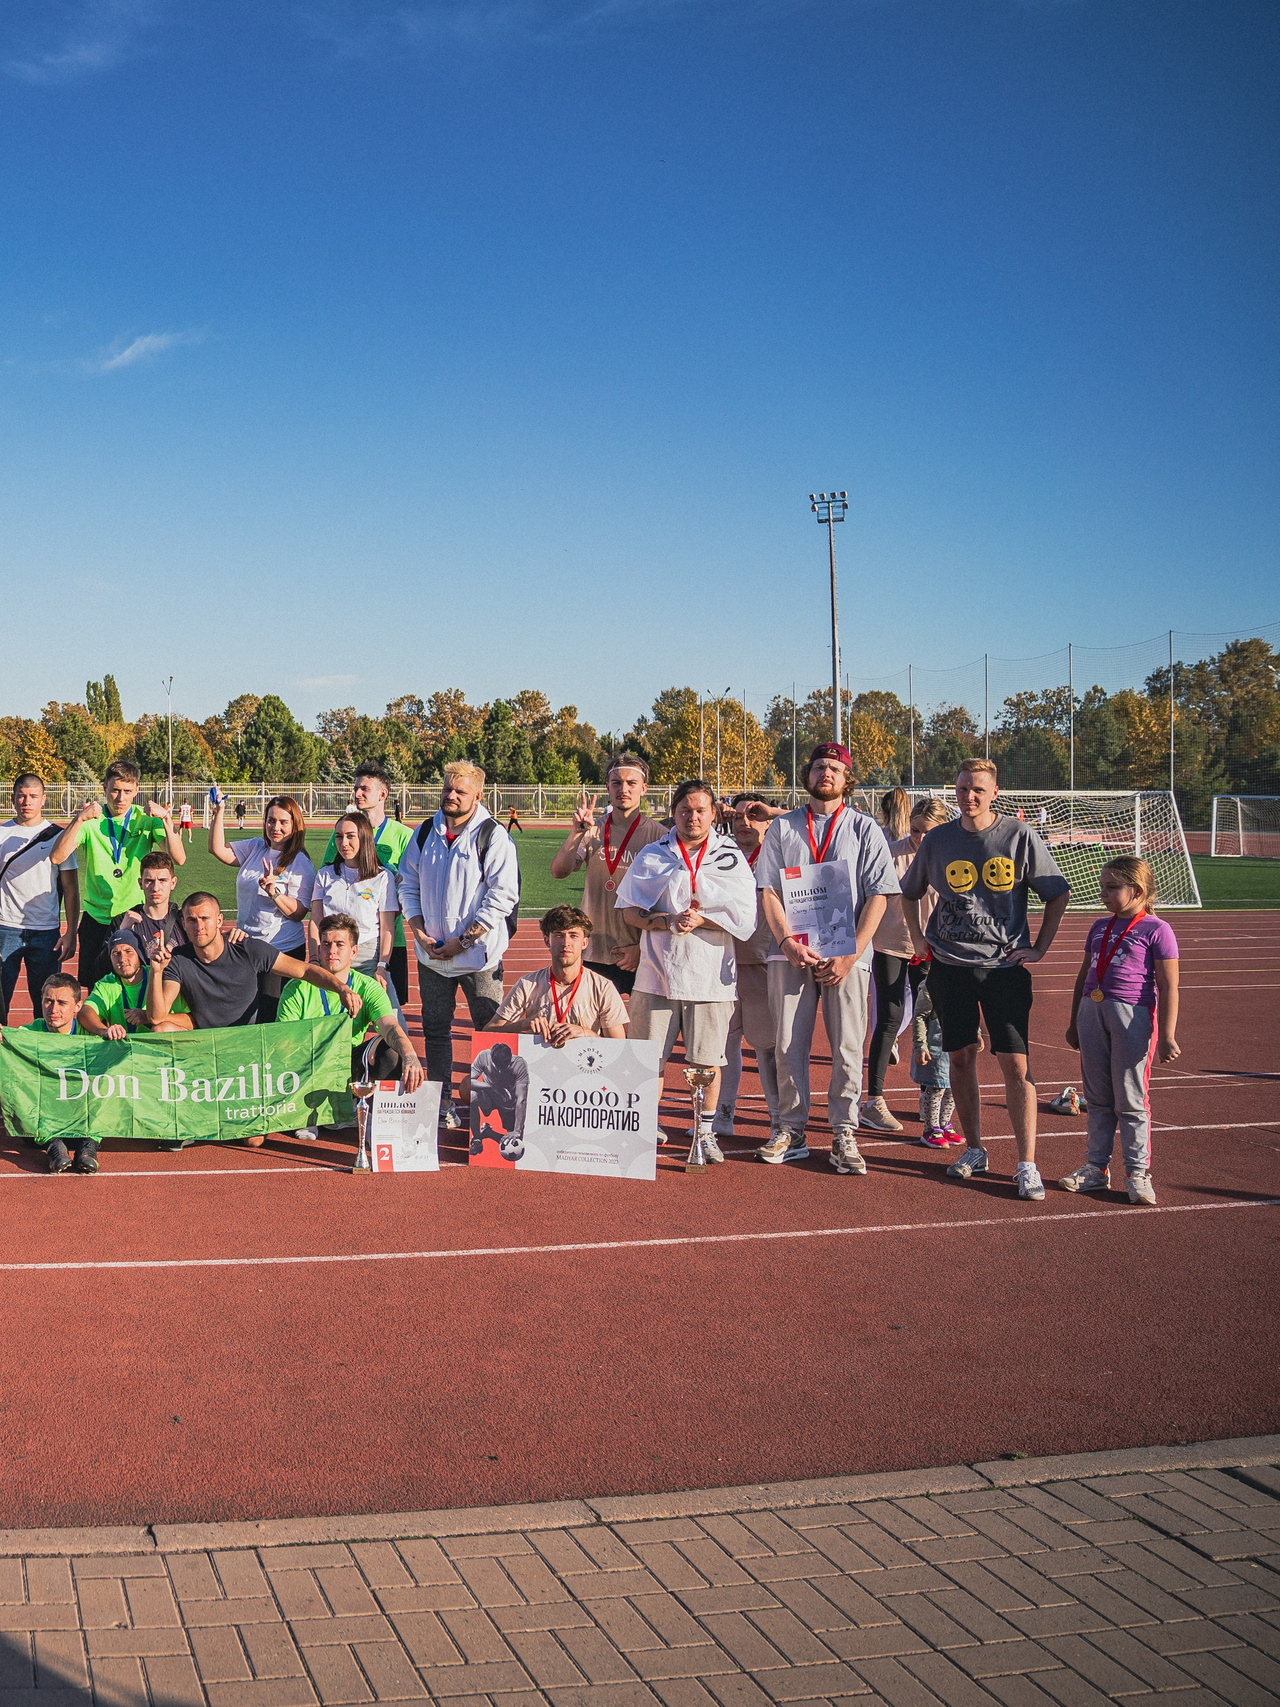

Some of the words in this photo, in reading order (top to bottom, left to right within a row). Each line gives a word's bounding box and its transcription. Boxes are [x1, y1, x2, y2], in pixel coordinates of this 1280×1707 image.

[599, 846, 638, 864] SUNN
[54, 1066, 142, 1101] Don
[156, 1062, 300, 1103] Bazilio
[539, 1087, 567, 1104] 30
[573, 1089, 619, 1108] 000
[225, 1099, 297, 1121] trattoria
[538, 1105, 556, 1127] НА
[557, 1106, 641, 1132] КОРПОРАТИВ
[379, 1146, 391, 1161] 2
[556, 1154, 578, 1162] MADYAR
[577, 1156, 608, 1164] COLLECTION
